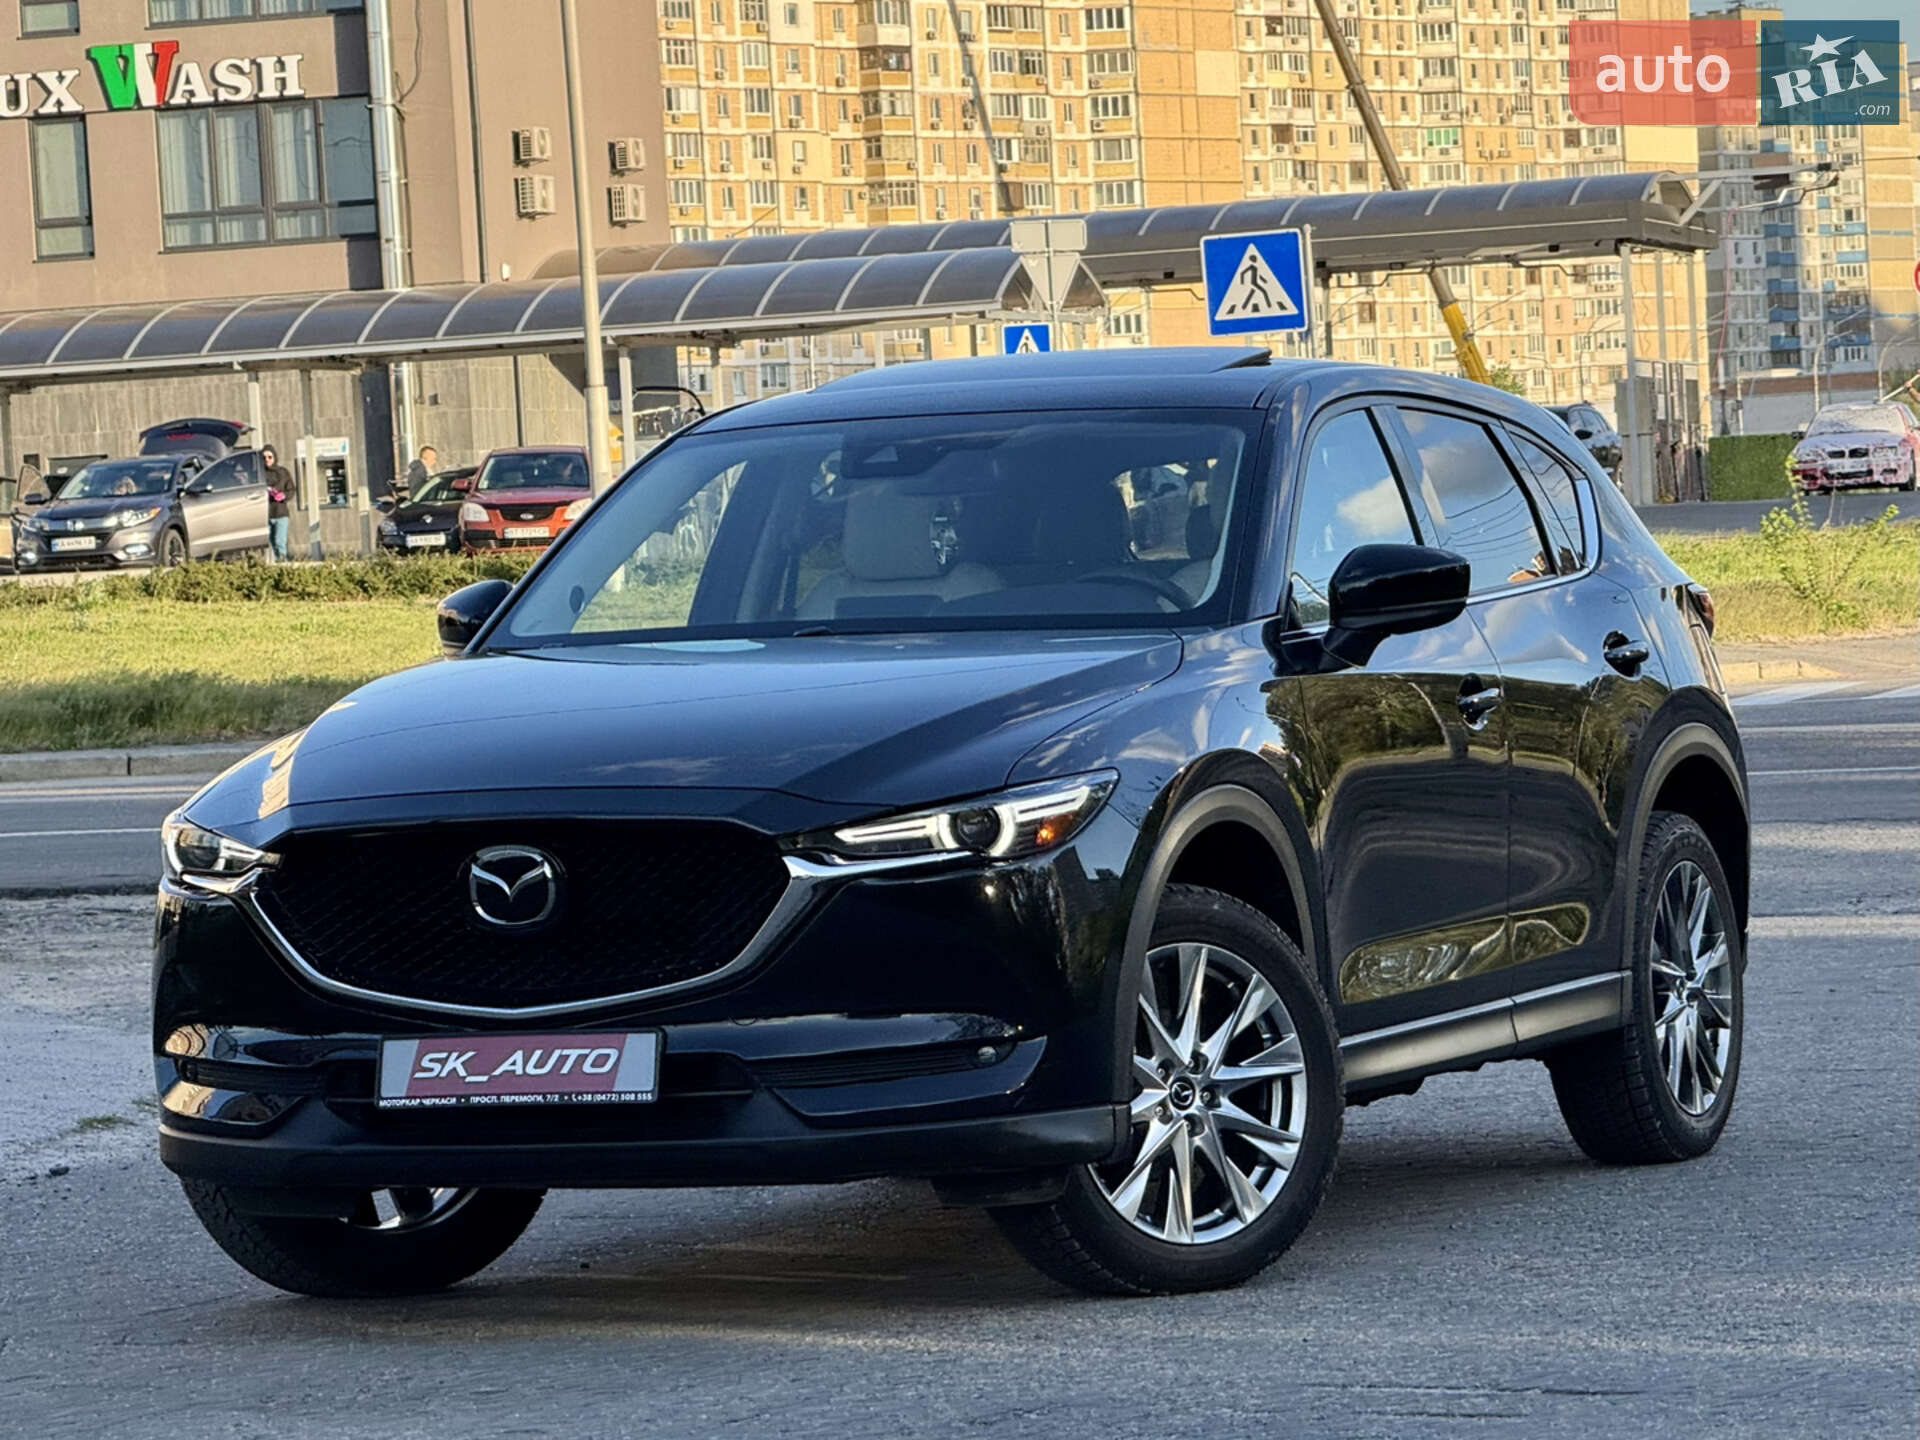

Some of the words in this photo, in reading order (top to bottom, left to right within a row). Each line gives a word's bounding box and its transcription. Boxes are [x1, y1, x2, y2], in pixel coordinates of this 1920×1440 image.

[86, 40, 305, 109] WASH
[413, 1048, 619, 1082] SK_AUTO
[379, 1098, 420, 1107] МОТОРКАР
[421, 1096, 457, 1105] ЧЕРКАСИ
[545, 1093, 560, 1102] 7/2
[593, 1092, 619, 1103] (0472)
